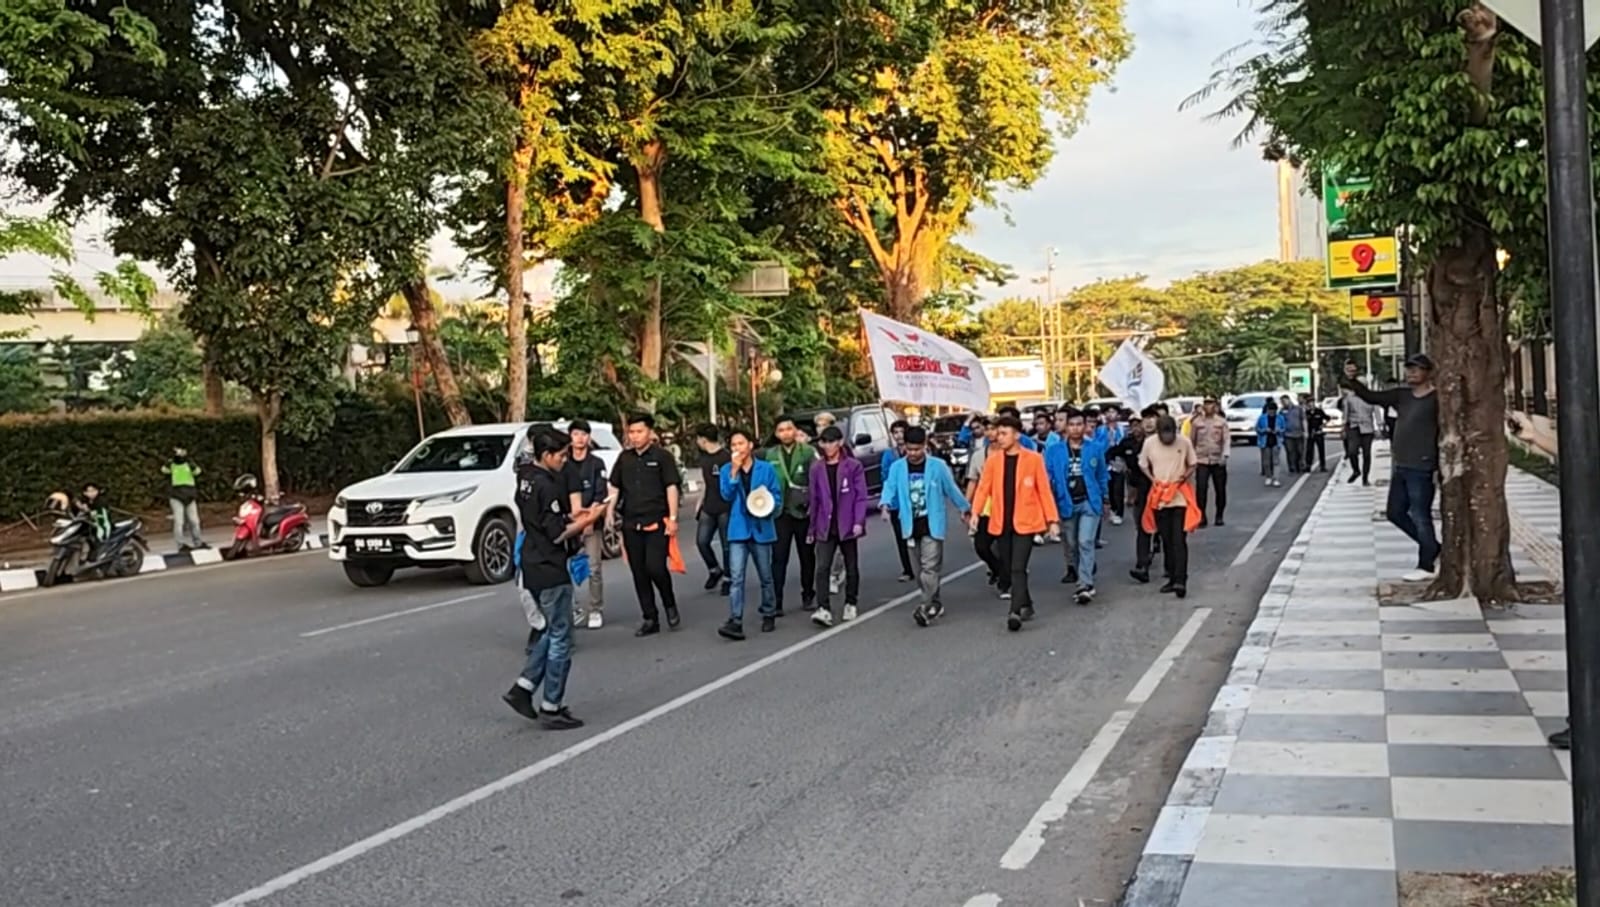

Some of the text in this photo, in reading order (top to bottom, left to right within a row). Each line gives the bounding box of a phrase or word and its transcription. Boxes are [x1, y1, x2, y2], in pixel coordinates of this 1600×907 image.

[1352, 243, 1376, 273] 9
[1366, 296, 1383, 317] 9
[892, 354, 944, 374] BEM
